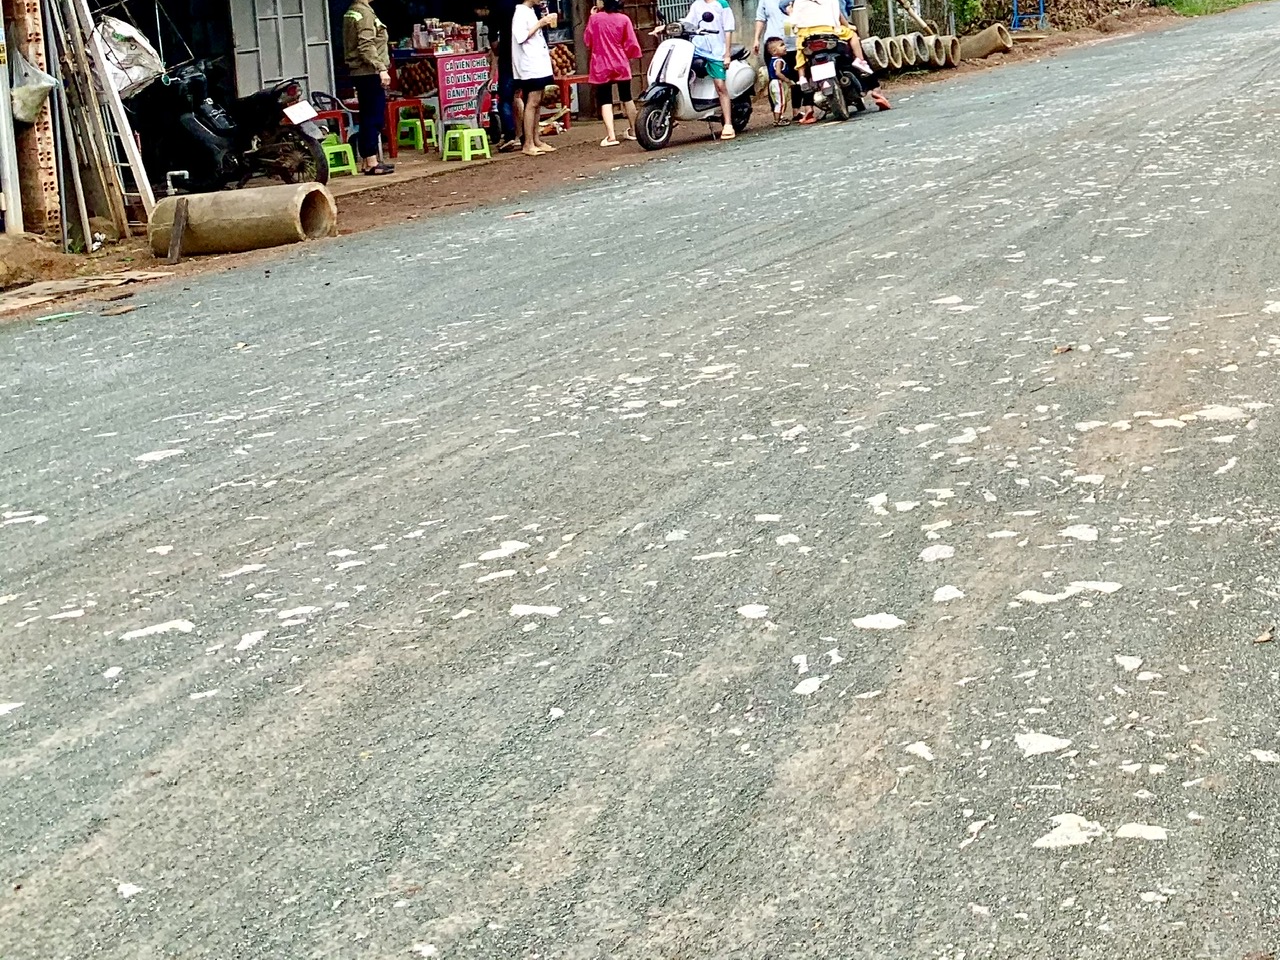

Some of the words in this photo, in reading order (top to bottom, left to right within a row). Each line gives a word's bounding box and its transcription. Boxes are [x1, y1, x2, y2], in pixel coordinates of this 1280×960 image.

[445, 60, 454, 71] CÁ
[455, 58, 470, 70] VIÊN
[456, 72, 471, 84] VIÊN
[447, 86, 465, 99] BÁNH
